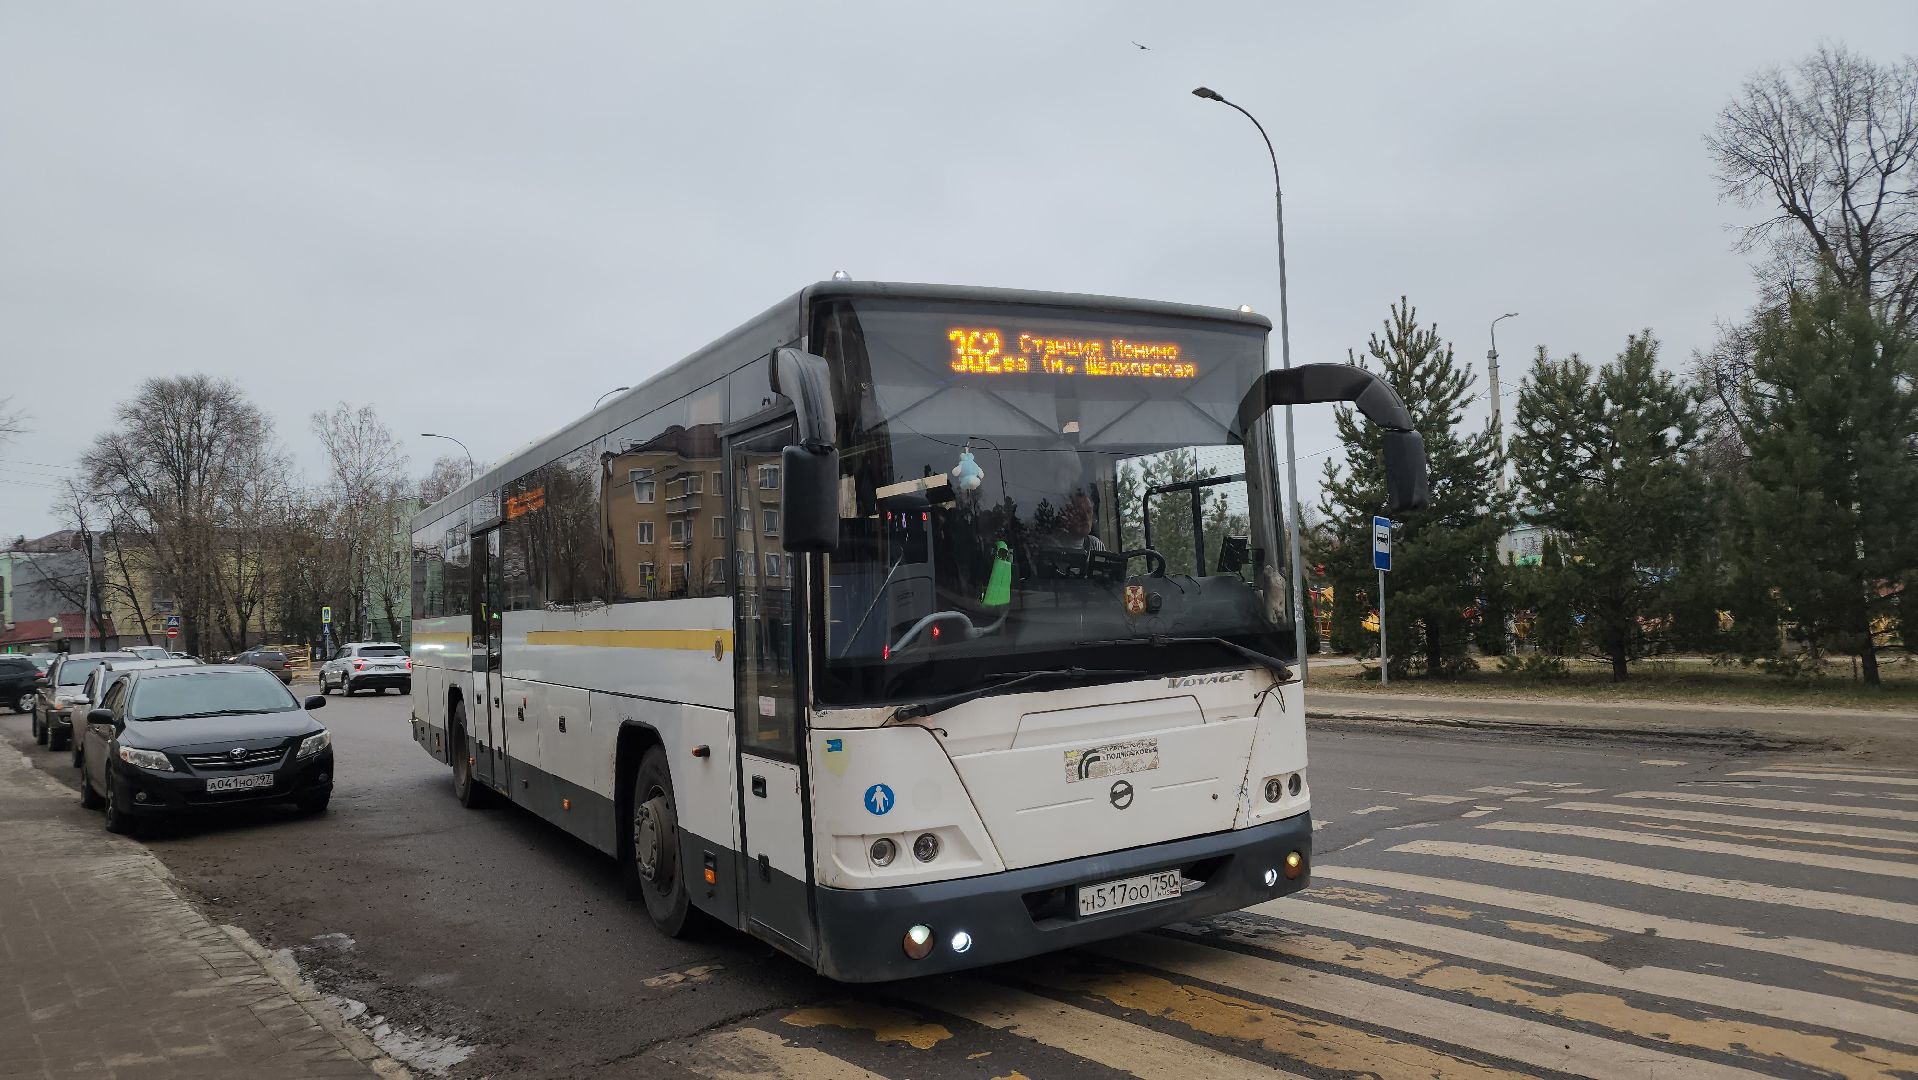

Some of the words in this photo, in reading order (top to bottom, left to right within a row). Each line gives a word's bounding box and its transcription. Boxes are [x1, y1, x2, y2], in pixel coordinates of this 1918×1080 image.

[1019, 333, 1102, 356] Станция
[1111, 338, 1178, 360] Монино
[1167, 672, 1245, 688] VOYAGE
